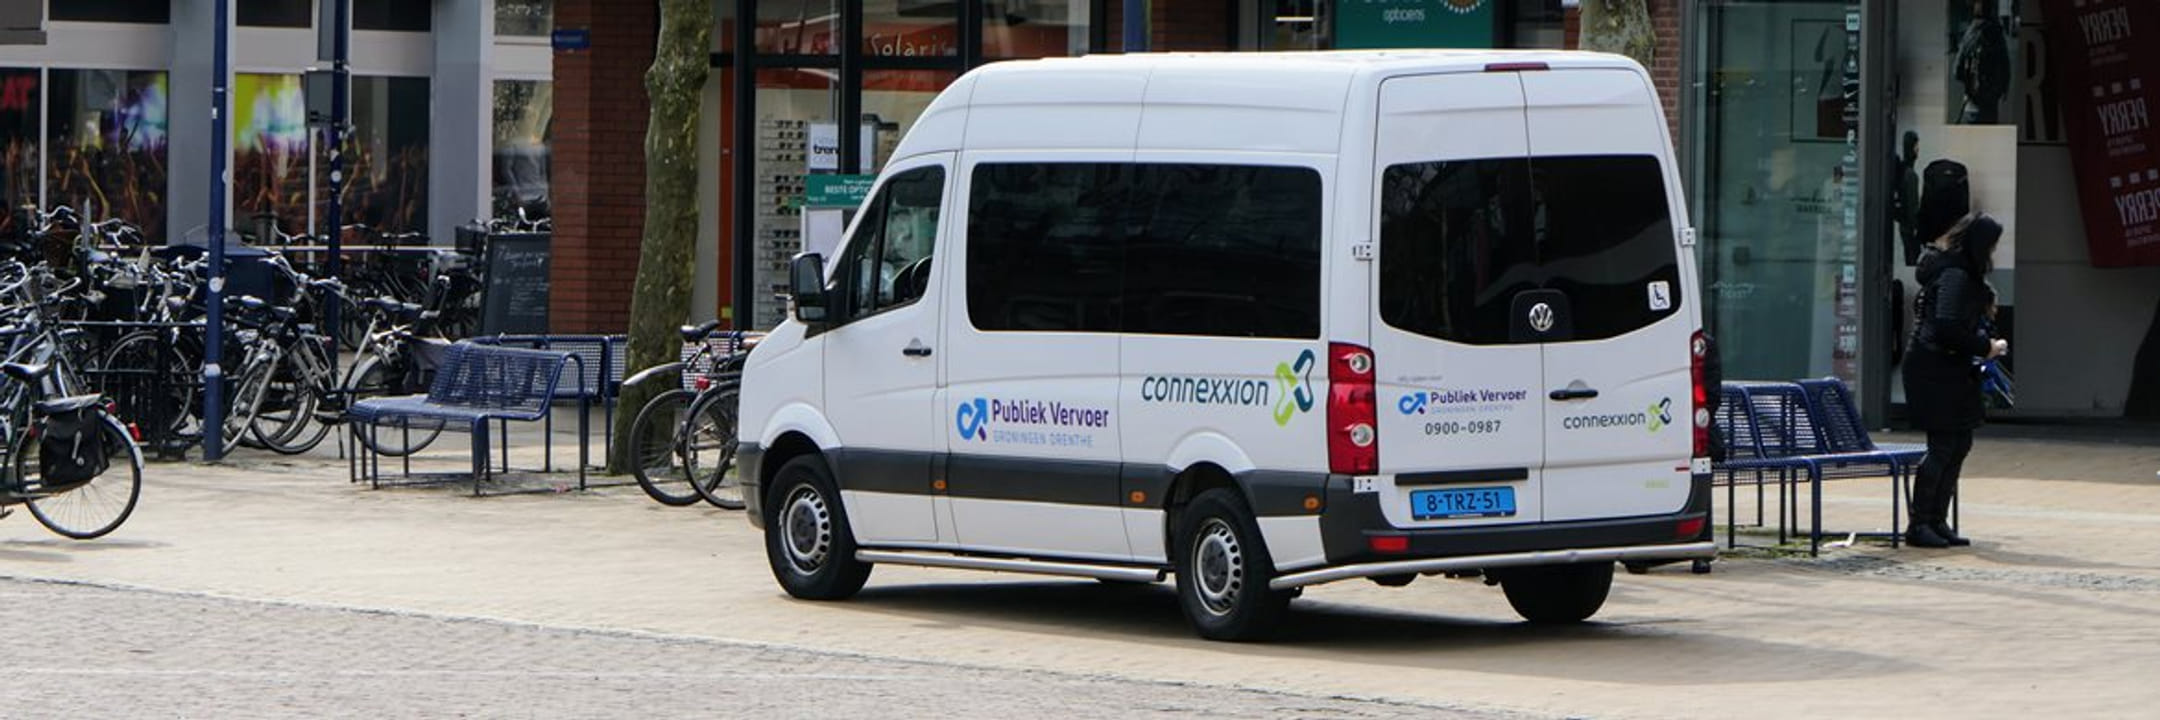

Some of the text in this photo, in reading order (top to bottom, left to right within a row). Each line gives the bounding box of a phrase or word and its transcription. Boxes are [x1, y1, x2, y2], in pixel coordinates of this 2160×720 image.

[1141, 376, 1269, 406] connexxion
[1431, 389, 1527, 404] Publiek Vervoer
[991, 399, 1109, 428] Publiek Vervoer
[1563, 412, 1646, 430] connexxion
[1425, 420, 1502, 436] 0900-0987
[993, 430, 1093, 448] GRONINGEN DRENTHE
[1426, 491, 1501, 512] 8-TRZ-51
